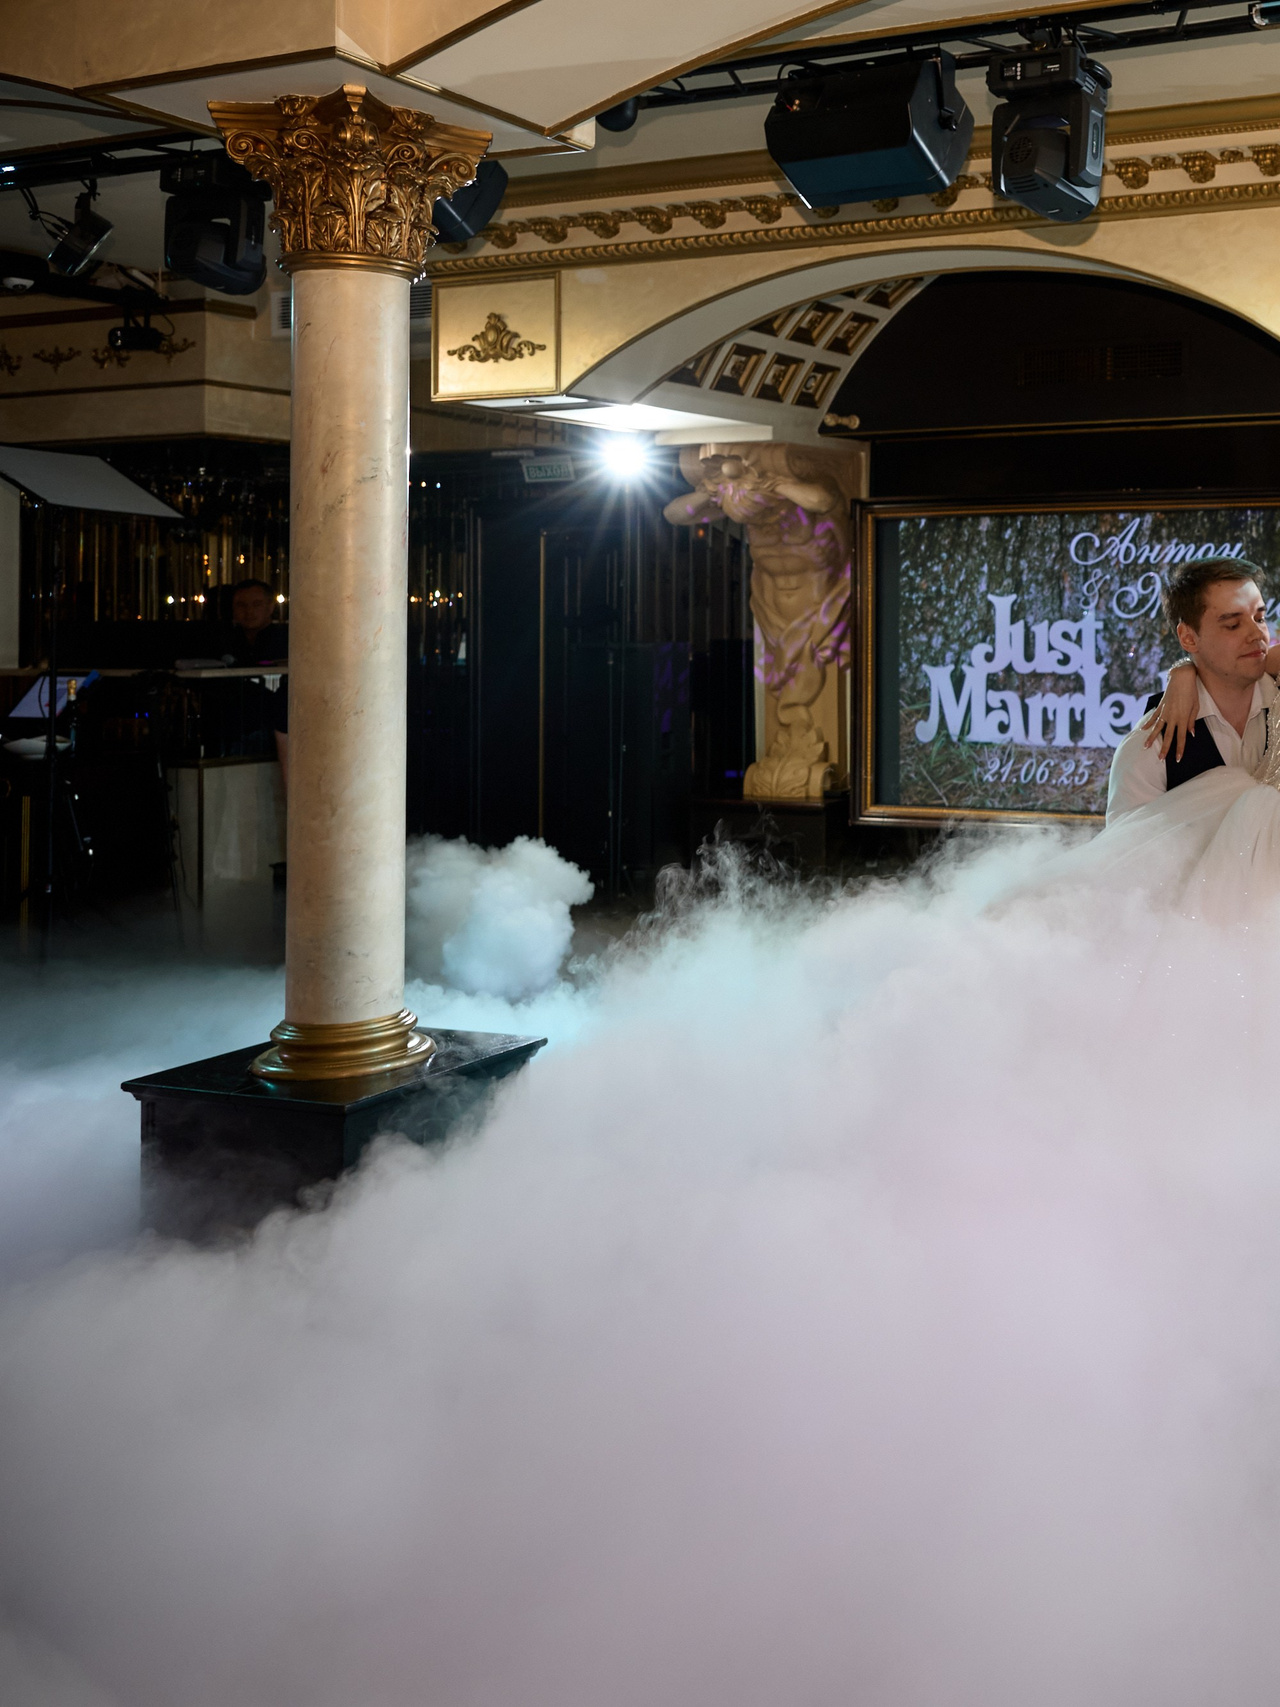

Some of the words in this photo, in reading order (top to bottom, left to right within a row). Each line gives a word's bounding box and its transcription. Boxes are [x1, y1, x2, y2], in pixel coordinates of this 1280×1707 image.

[528, 465, 569, 479] ВЫХОД
[1069, 517, 1247, 565] Антон
[970, 593, 1104, 674] Just
[982, 757, 1094, 786] 21.06.25
